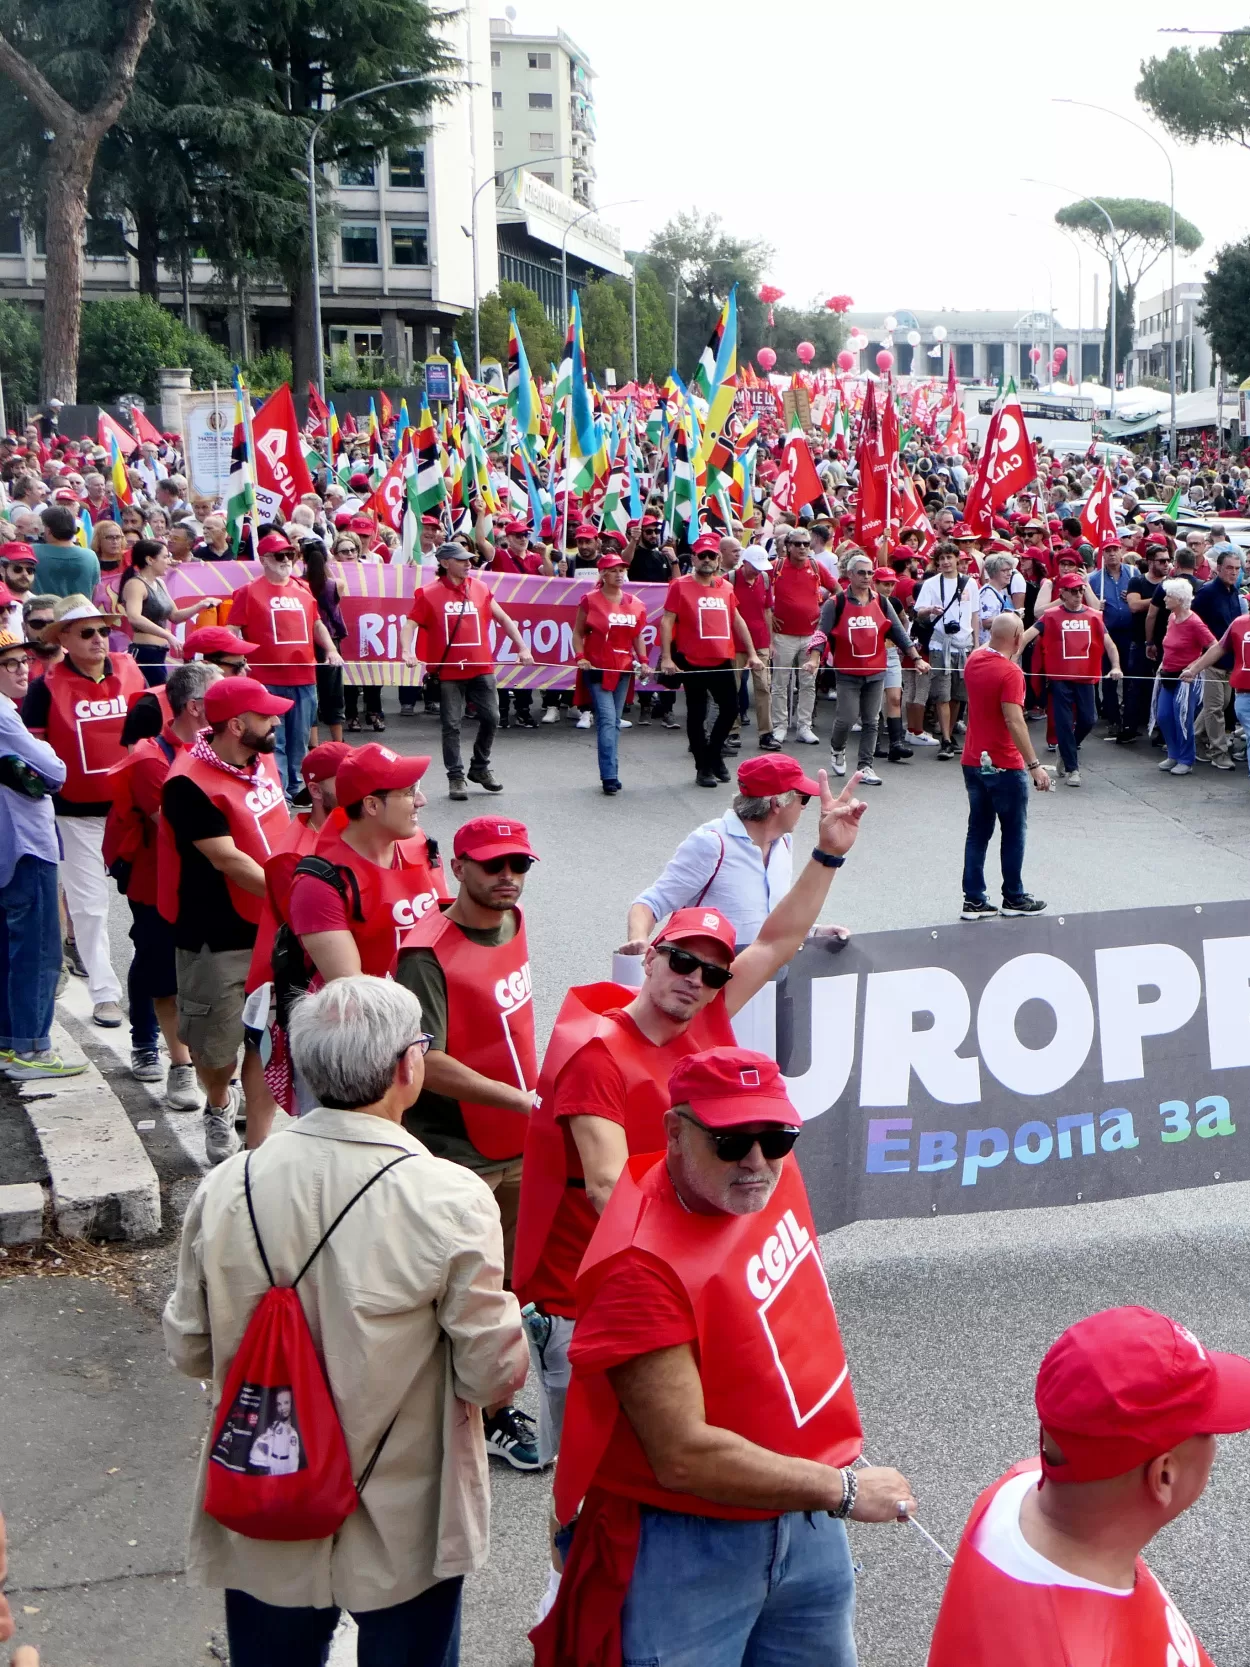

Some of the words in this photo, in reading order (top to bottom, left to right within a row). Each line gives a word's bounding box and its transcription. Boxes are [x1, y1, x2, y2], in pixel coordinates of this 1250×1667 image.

[270, 597, 304, 609] CGIL
[444, 601, 478, 613] CGIL
[698, 597, 727, 608] CGIL
[608, 613, 637, 625] CGIL
[848, 616, 876, 627] CGIL
[1062, 620, 1091, 630] CGIL
[75, 695, 128, 718] CGIL
[392, 888, 440, 926] CG
[866, 1107, 1140, 1187] Европа
[1160, 1095, 1237, 1145] за
[745, 1208, 810, 1301] CGIL
